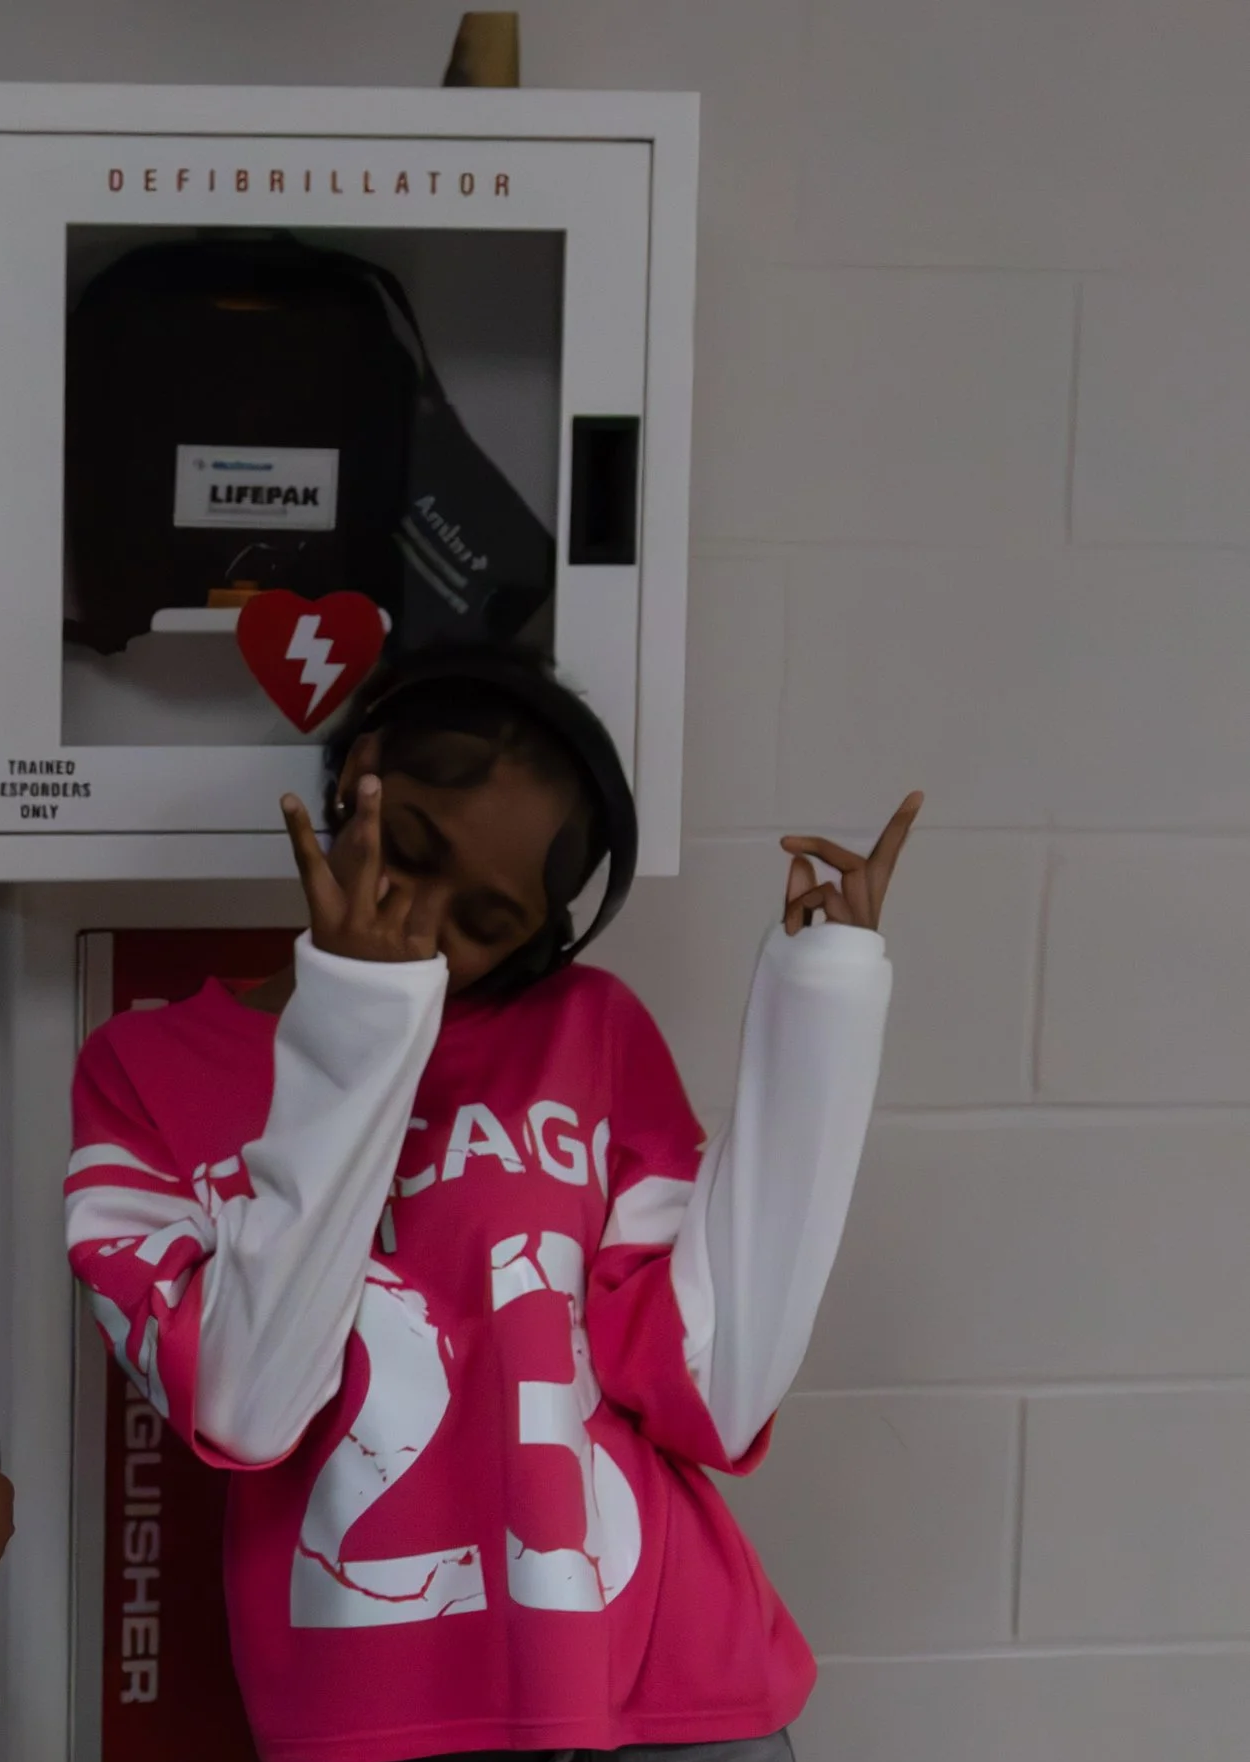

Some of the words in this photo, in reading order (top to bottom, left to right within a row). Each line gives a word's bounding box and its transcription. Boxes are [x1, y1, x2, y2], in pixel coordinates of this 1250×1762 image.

[108, 168, 510, 197] DEFIBRILLATOR
[209, 485, 320, 507] LIFEPAK
[8, 759, 76, 776] TRAINED
[20, 804, 59, 820] ONLY
[290, 1230, 642, 1628] 23
